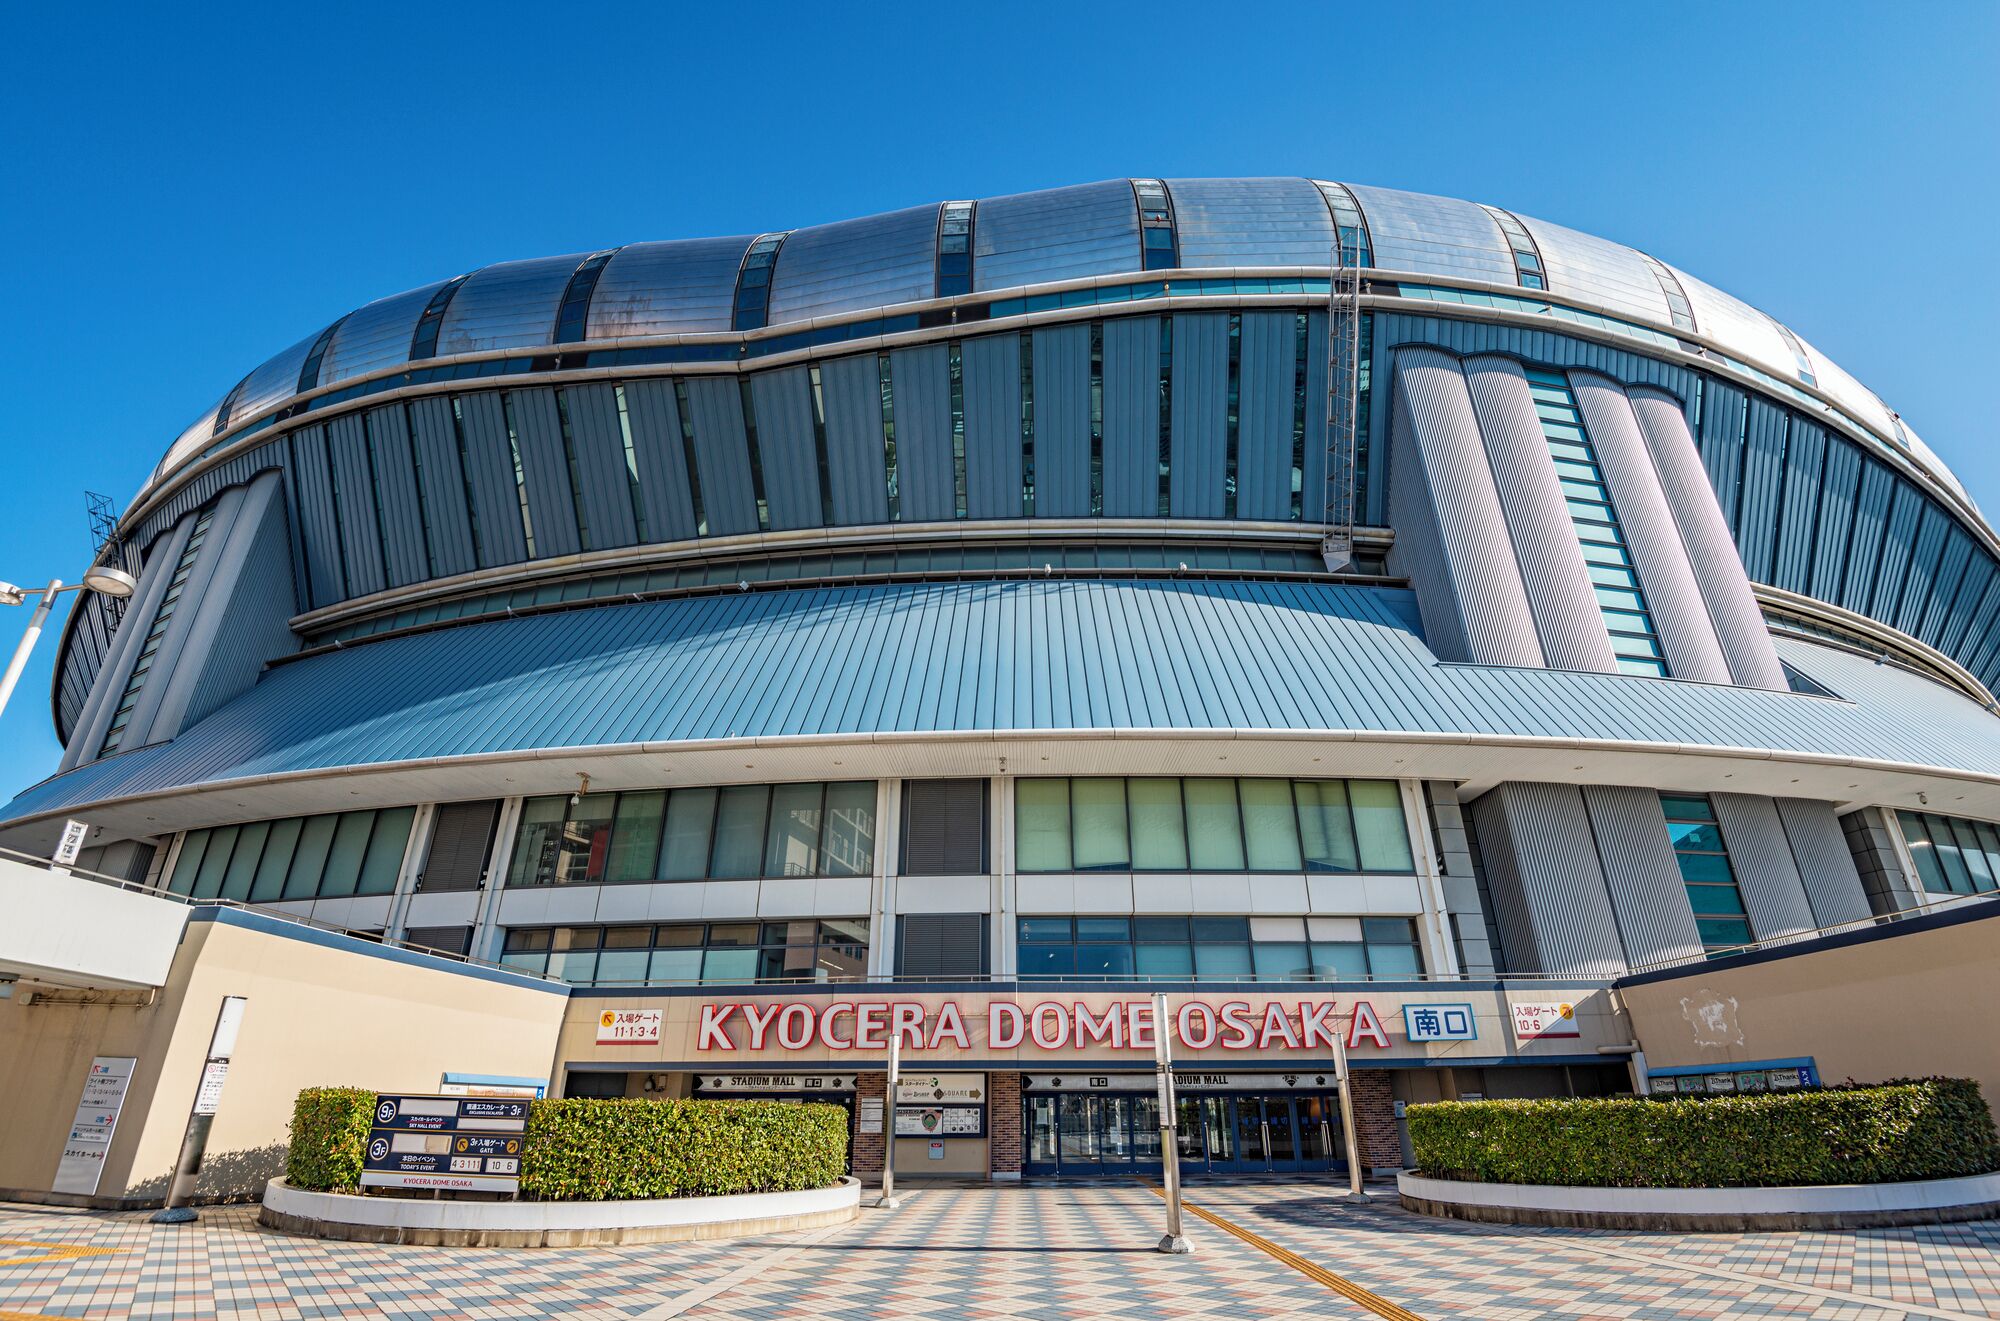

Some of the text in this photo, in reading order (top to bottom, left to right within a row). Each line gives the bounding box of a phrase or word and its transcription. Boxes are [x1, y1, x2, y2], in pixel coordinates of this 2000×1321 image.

[1515, 1006, 1557, 1016] 入場ゲート
[616, 1013, 659, 1023] 入場ゲート
[1413, 1008, 1468, 1036] 南口
[697, 1001, 1391, 1050] KYOCERA DOME OSAKA
[731, 1076, 796, 1086] STADIUM MALL
[1173, 1075, 1229, 1085] ADIUM MALL
[380, 1105, 394, 1118] 9F
[510, 1104, 522, 1116] 3F
[64, 1149, 97, 1158] スカイホール
[372, 1143, 386, 1156] 3F
[402, 1155, 437, 1163] 本日のイベント
